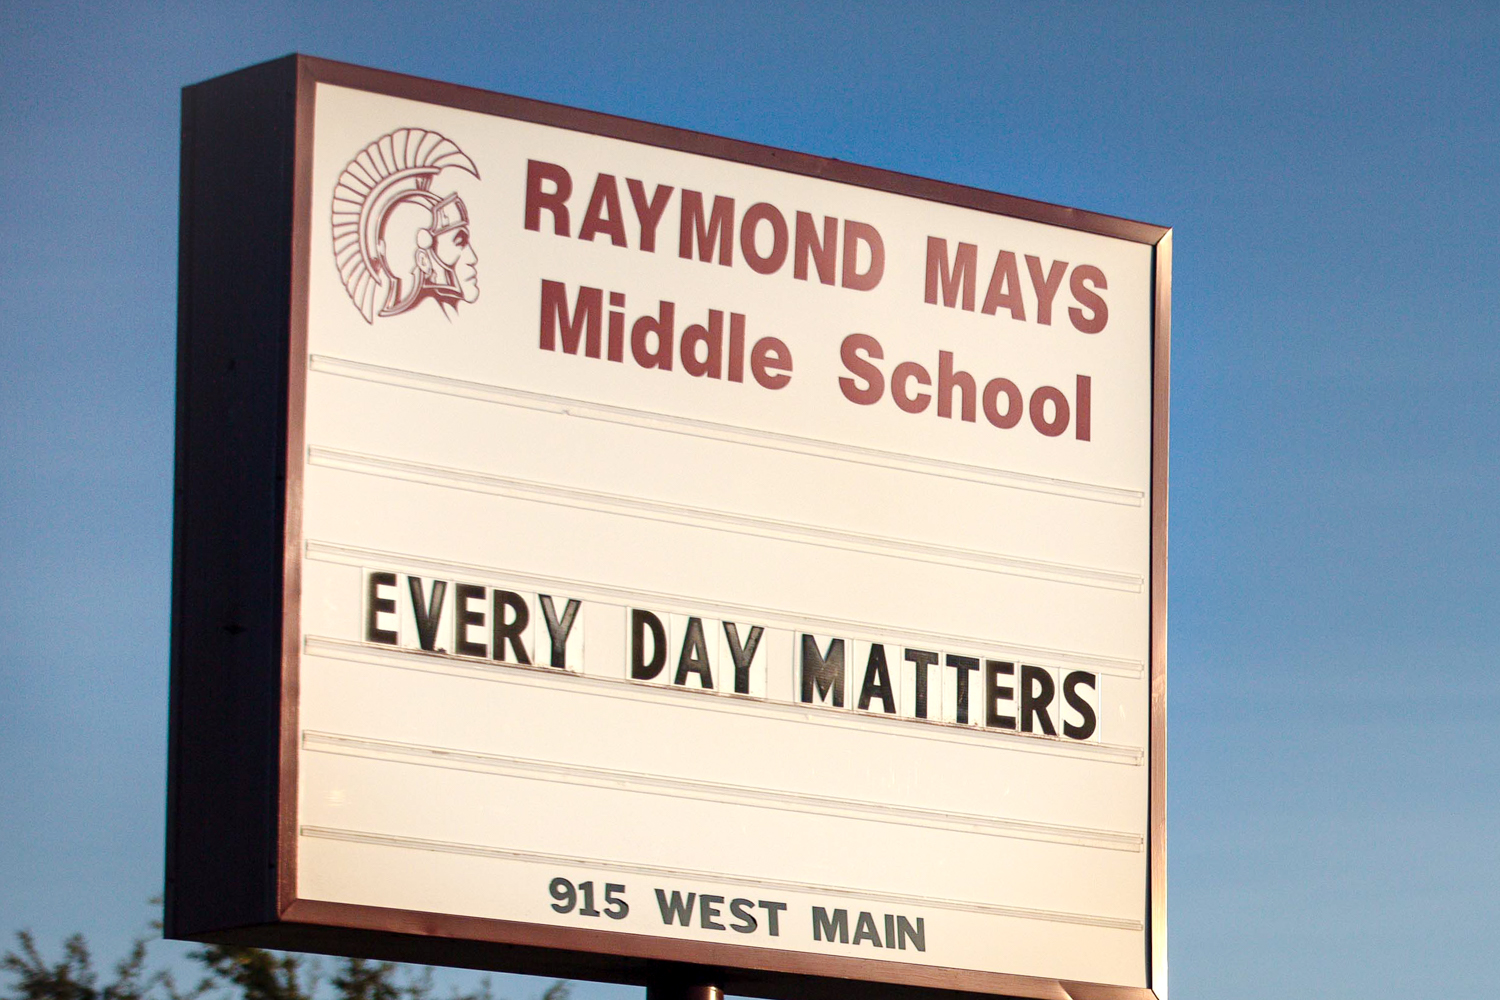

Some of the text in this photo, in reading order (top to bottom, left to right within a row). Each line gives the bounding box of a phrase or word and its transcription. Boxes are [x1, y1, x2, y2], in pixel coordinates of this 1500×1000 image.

[524, 158, 1109, 334] RAYMOND MAYS
[539, 279, 1092, 442] Middle School
[366, 571, 1098, 741] EVERY DAY MATTERS
[548, 877, 926, 953] 915 WEST MAIN
